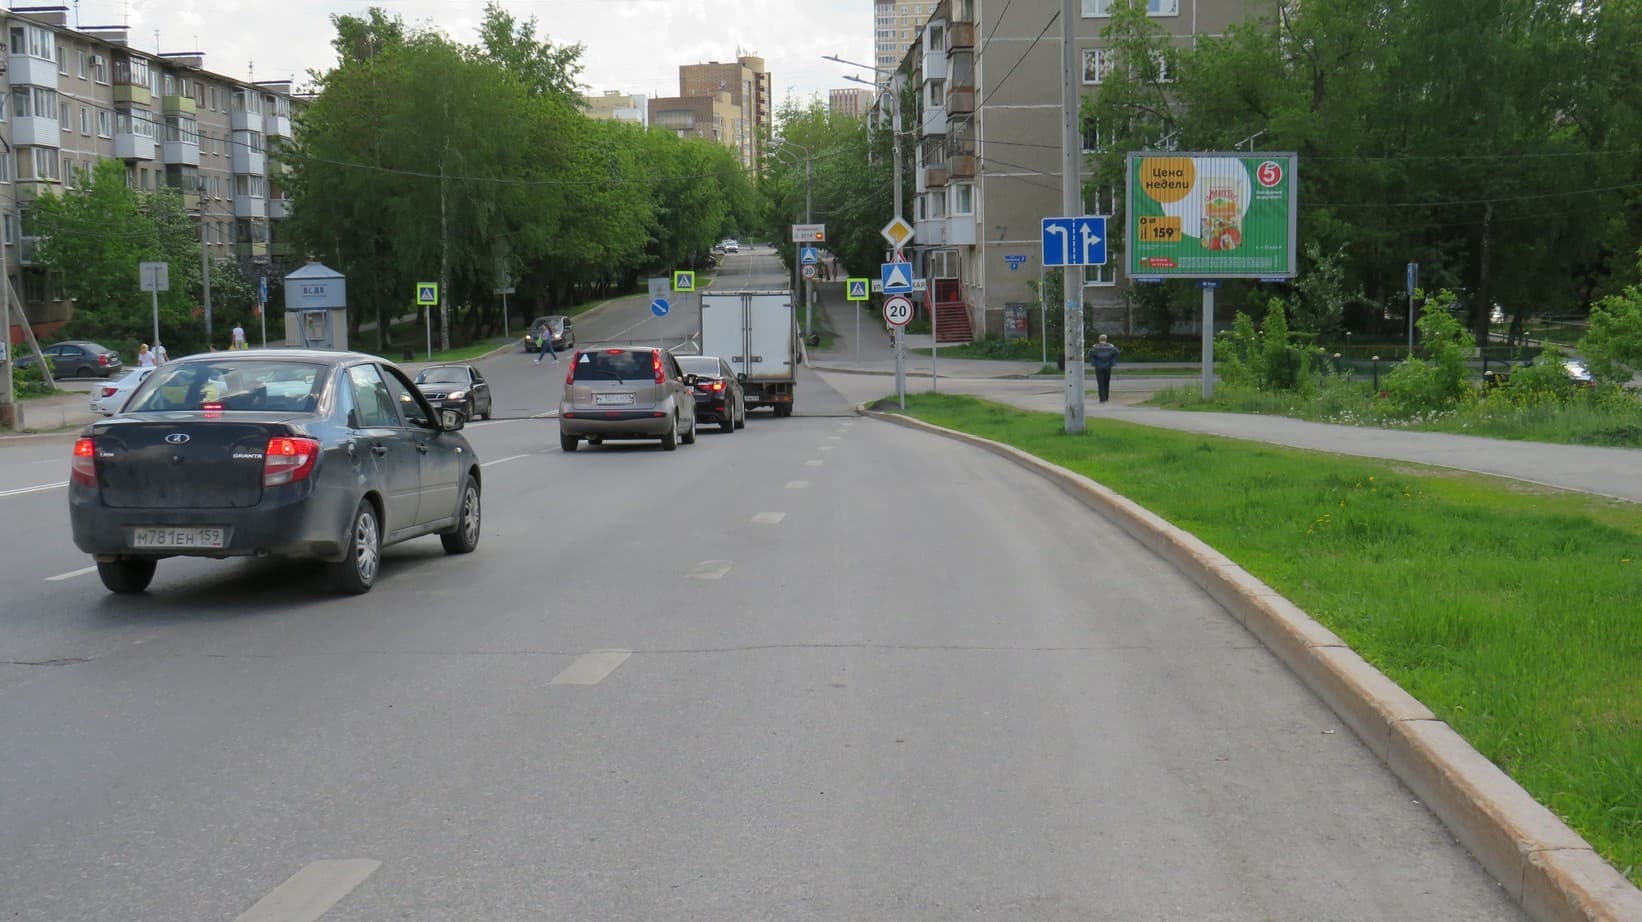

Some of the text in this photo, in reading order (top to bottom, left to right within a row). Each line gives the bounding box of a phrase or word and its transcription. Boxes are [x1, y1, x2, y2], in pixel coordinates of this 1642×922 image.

[1152, 168, 1184, 179] Цена
[1146, 180, 1189, 190] недели
[1153, 227, 1174, 238] 159
[805, 267, 814, 275] 20
[890, 305, 907, 317] 20
[198, 530, 219, 541] 159
